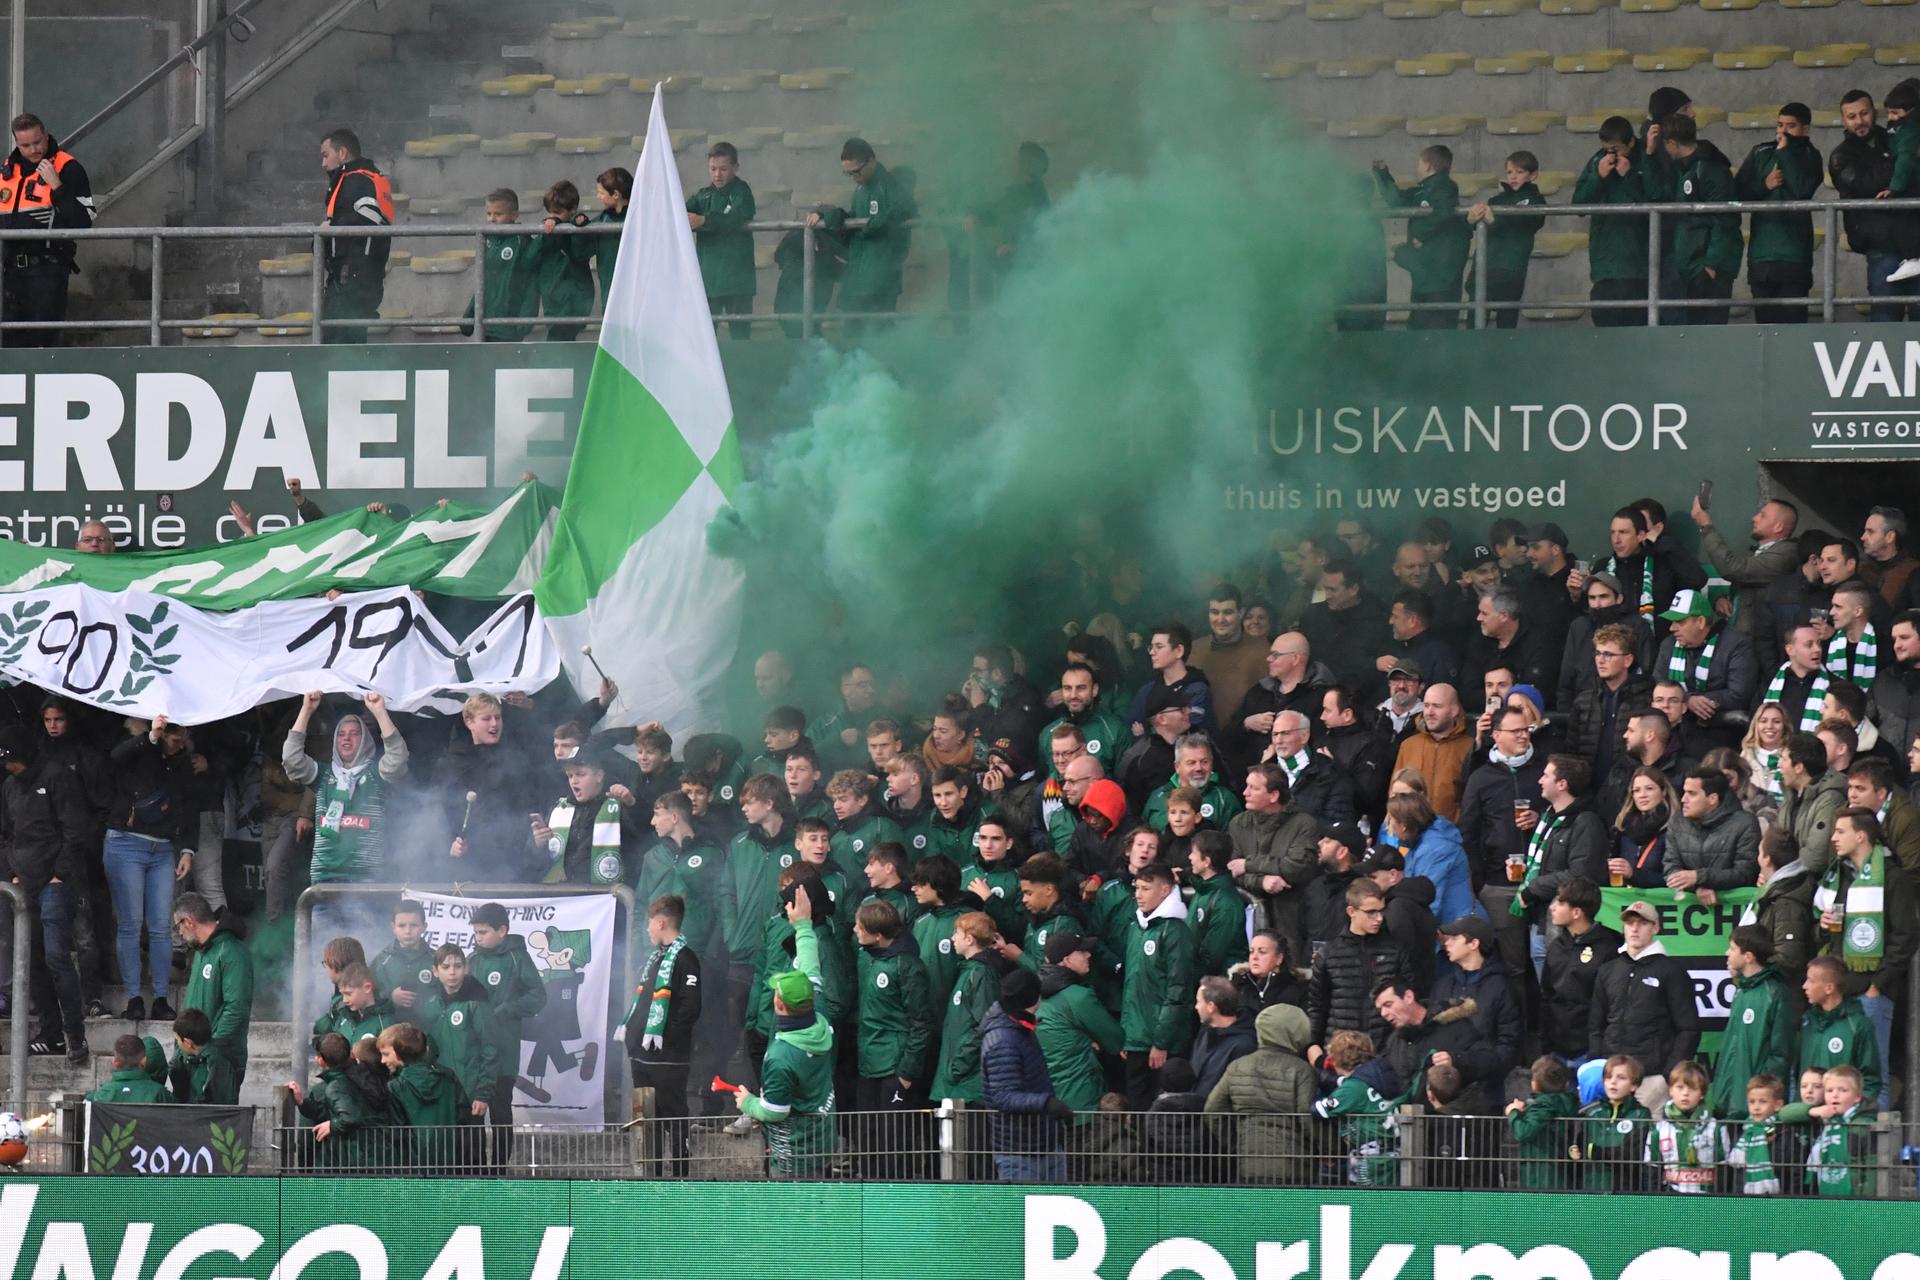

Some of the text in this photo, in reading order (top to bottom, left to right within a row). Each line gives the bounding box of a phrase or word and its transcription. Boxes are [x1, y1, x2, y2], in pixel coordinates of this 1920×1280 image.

[1251, 403, 1688, 455] UISKANTOOR
[1223, 479, 1566, 512] thuis in uw vastgoed
